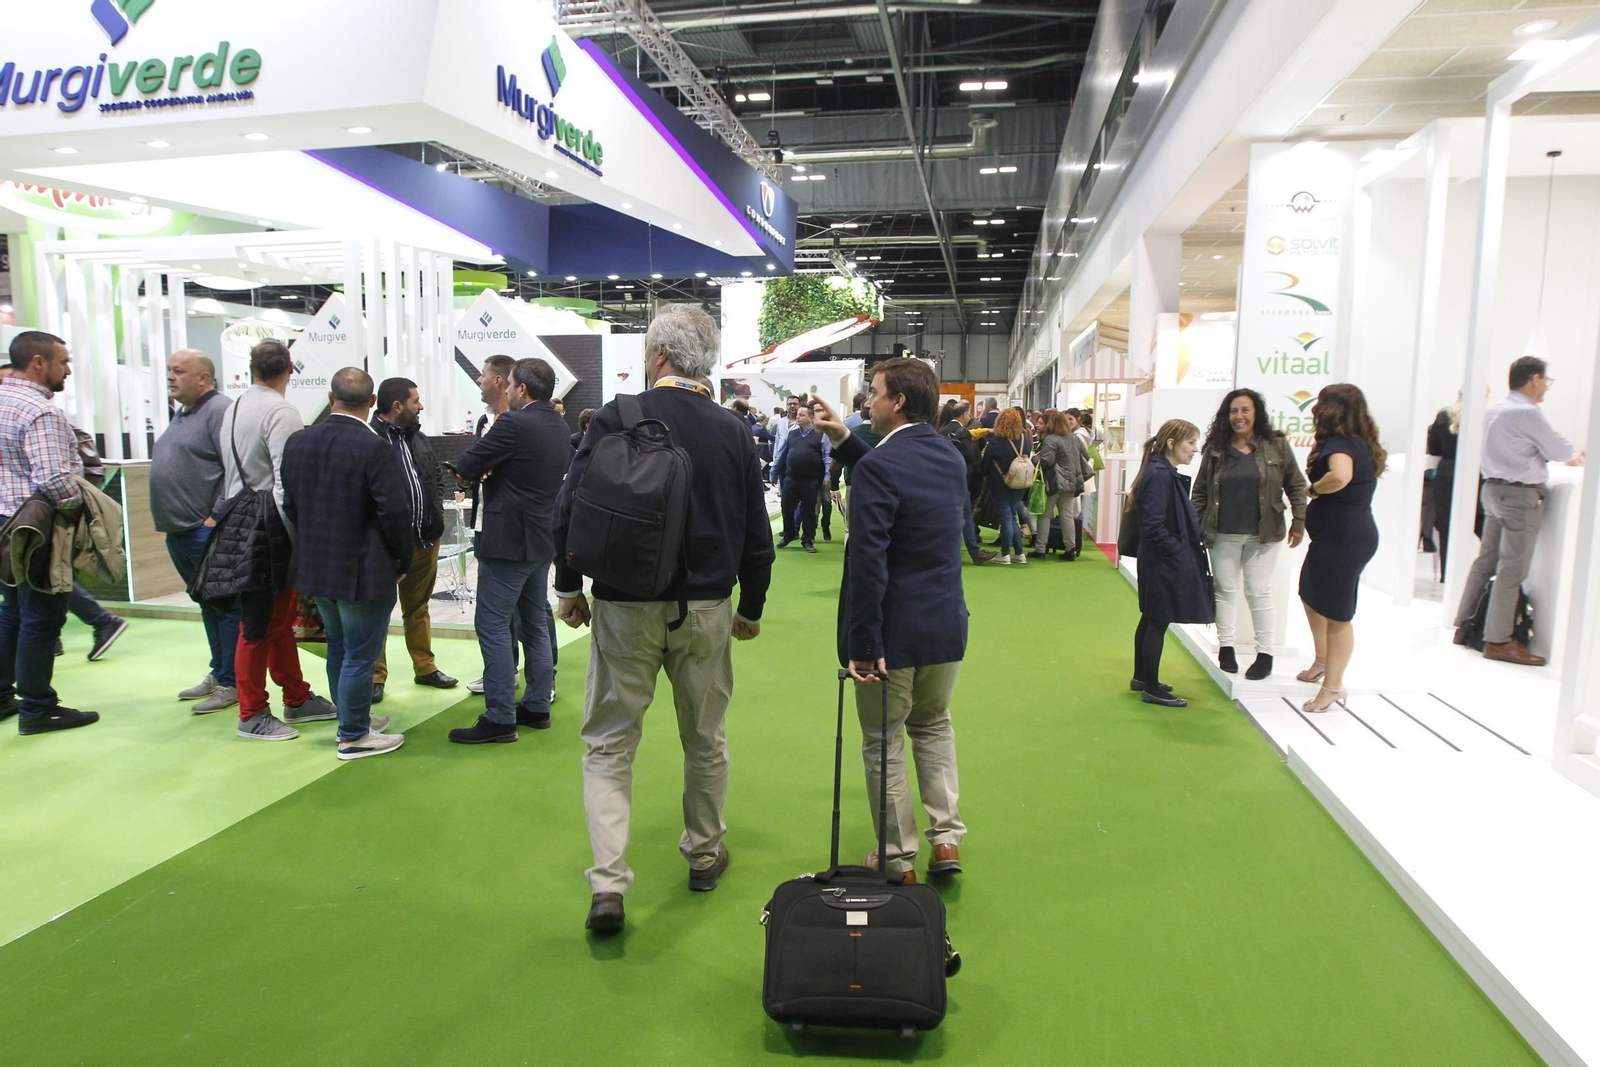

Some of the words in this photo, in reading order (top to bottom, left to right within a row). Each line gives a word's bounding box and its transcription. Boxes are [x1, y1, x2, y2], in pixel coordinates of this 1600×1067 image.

[496, 65, 604, 166] Murgiverde
[1289, 236, 1340, 250] solvit
[308, 332, 347, 344] Murgive
[457, 329, 517, 342] Murgiverde
[1256, 350, 1330, 375] vitaal
[288, 376, 327, 388] rgiverde
[1269, 409, 1318, 433] itaa
